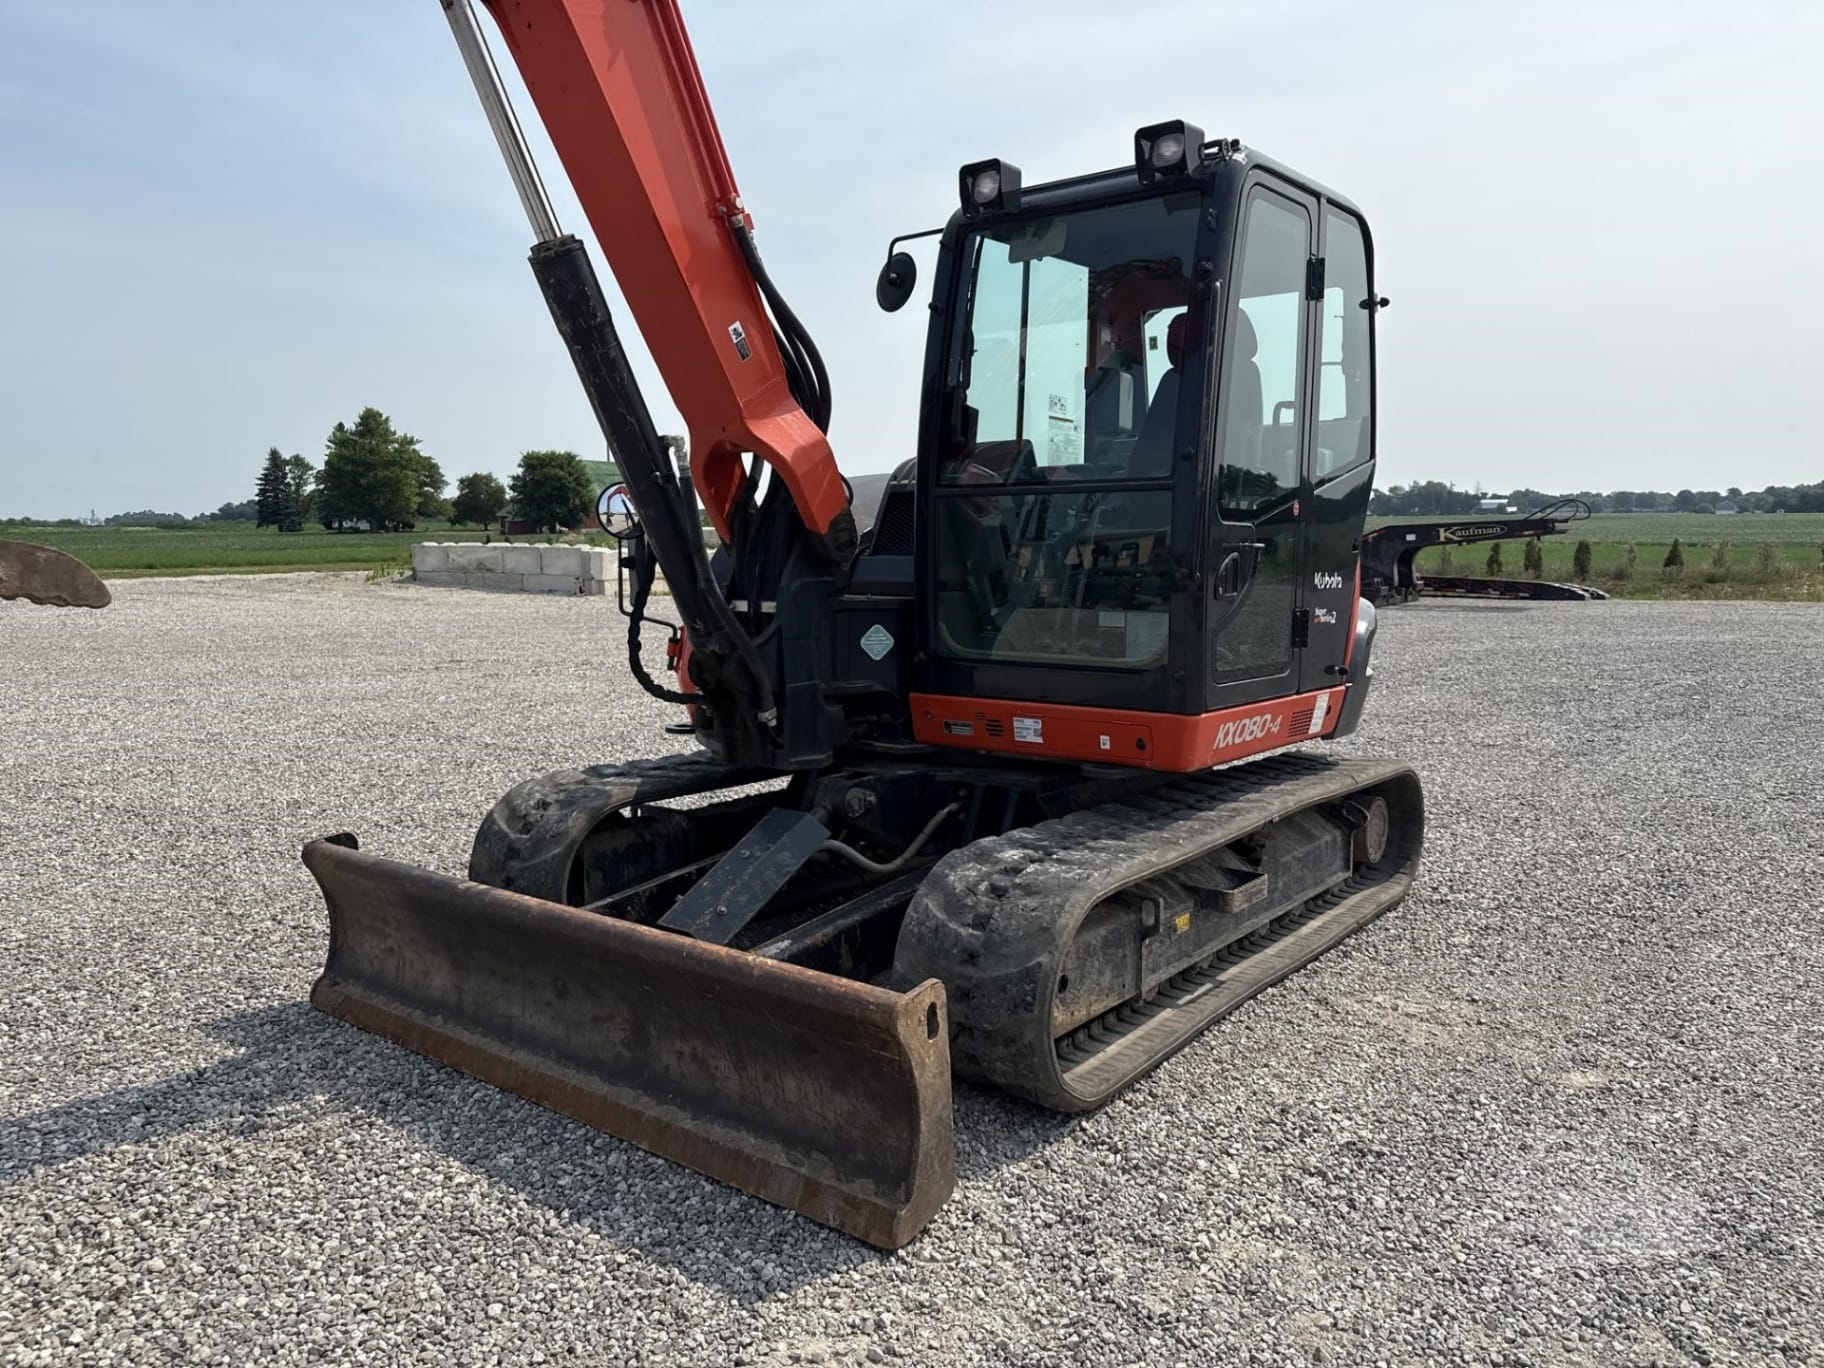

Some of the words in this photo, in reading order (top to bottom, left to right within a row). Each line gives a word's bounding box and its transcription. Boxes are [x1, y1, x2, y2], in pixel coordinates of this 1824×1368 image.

[1437, 526, 1501, 542] Kaufman
[1314, 572, 1342, 589] Kubota
[1213, 713, 1284, 750] KX080-4
